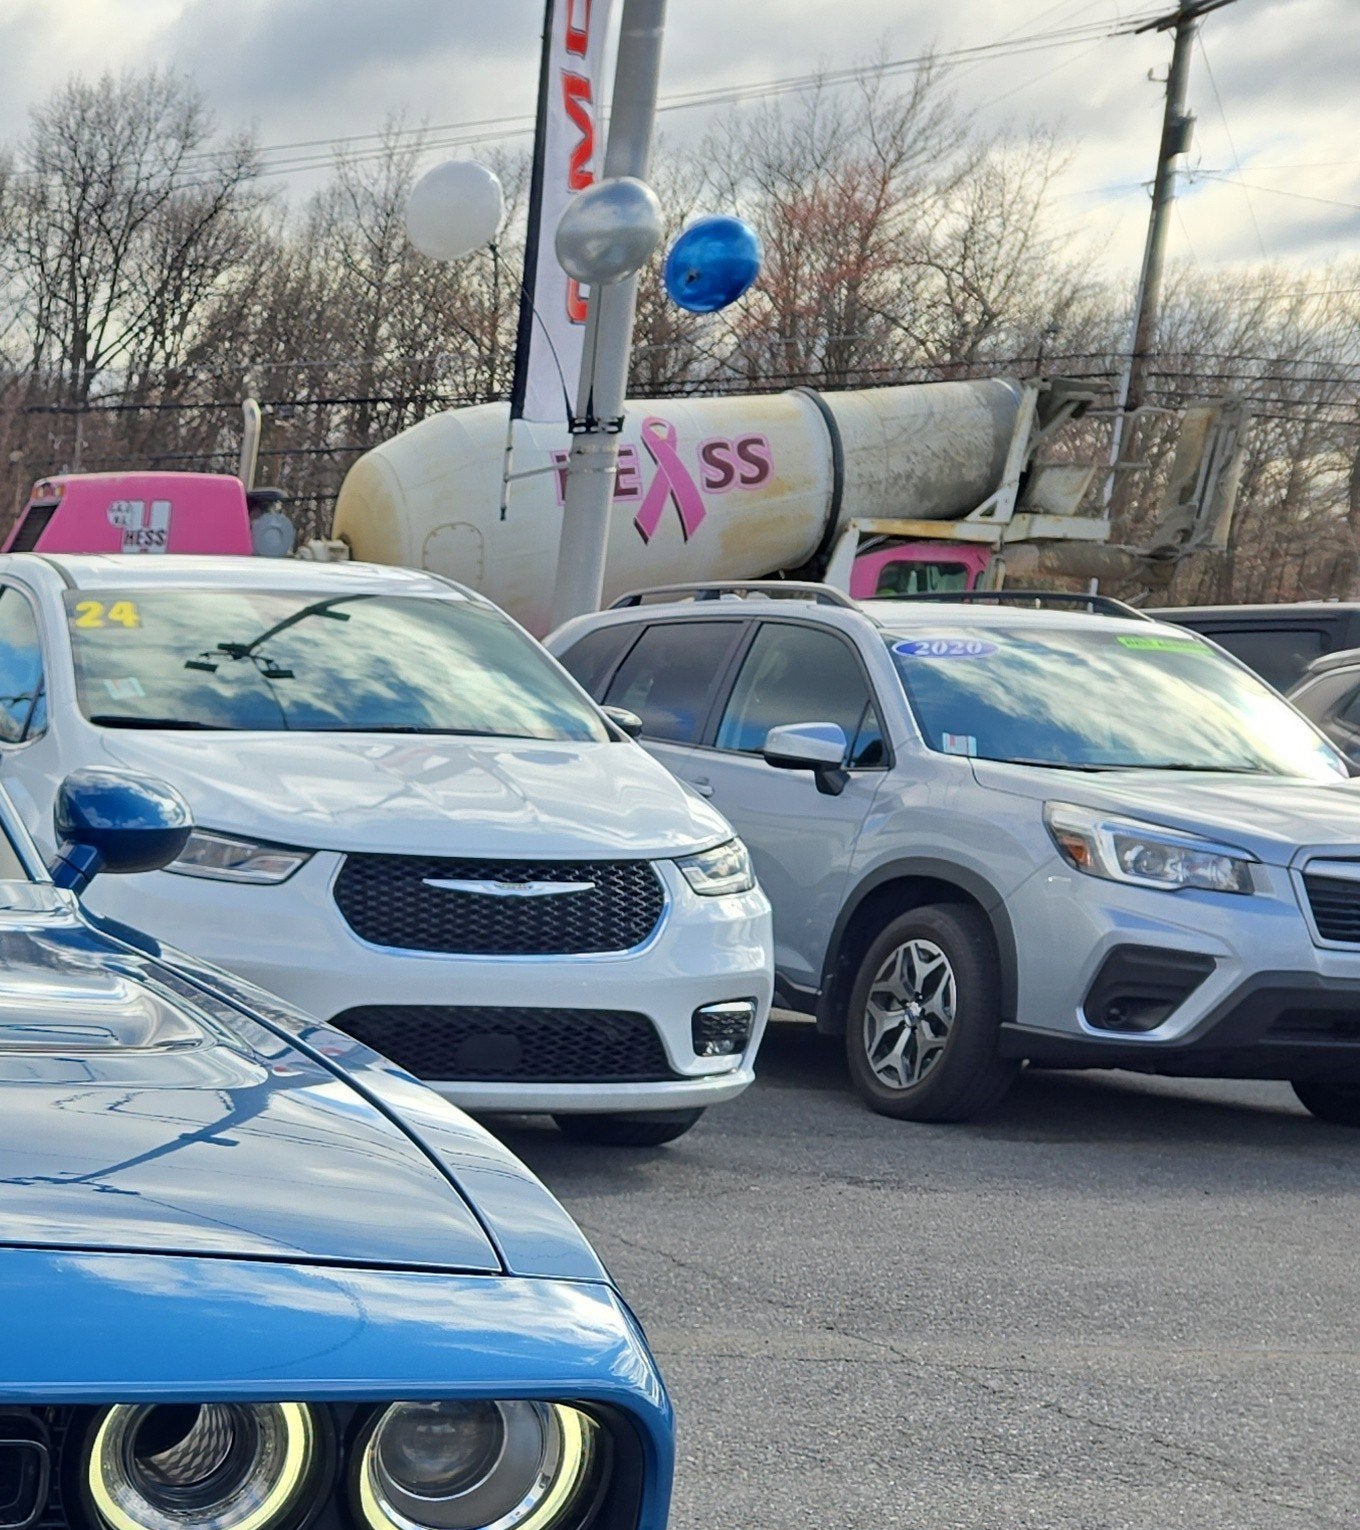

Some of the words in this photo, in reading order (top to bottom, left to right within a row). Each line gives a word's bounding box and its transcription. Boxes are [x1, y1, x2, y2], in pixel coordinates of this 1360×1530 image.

[556, 437, 770, 502] ESS
[75, 601, 140, 629] 24
[915, 641, 983, 656] 2020
